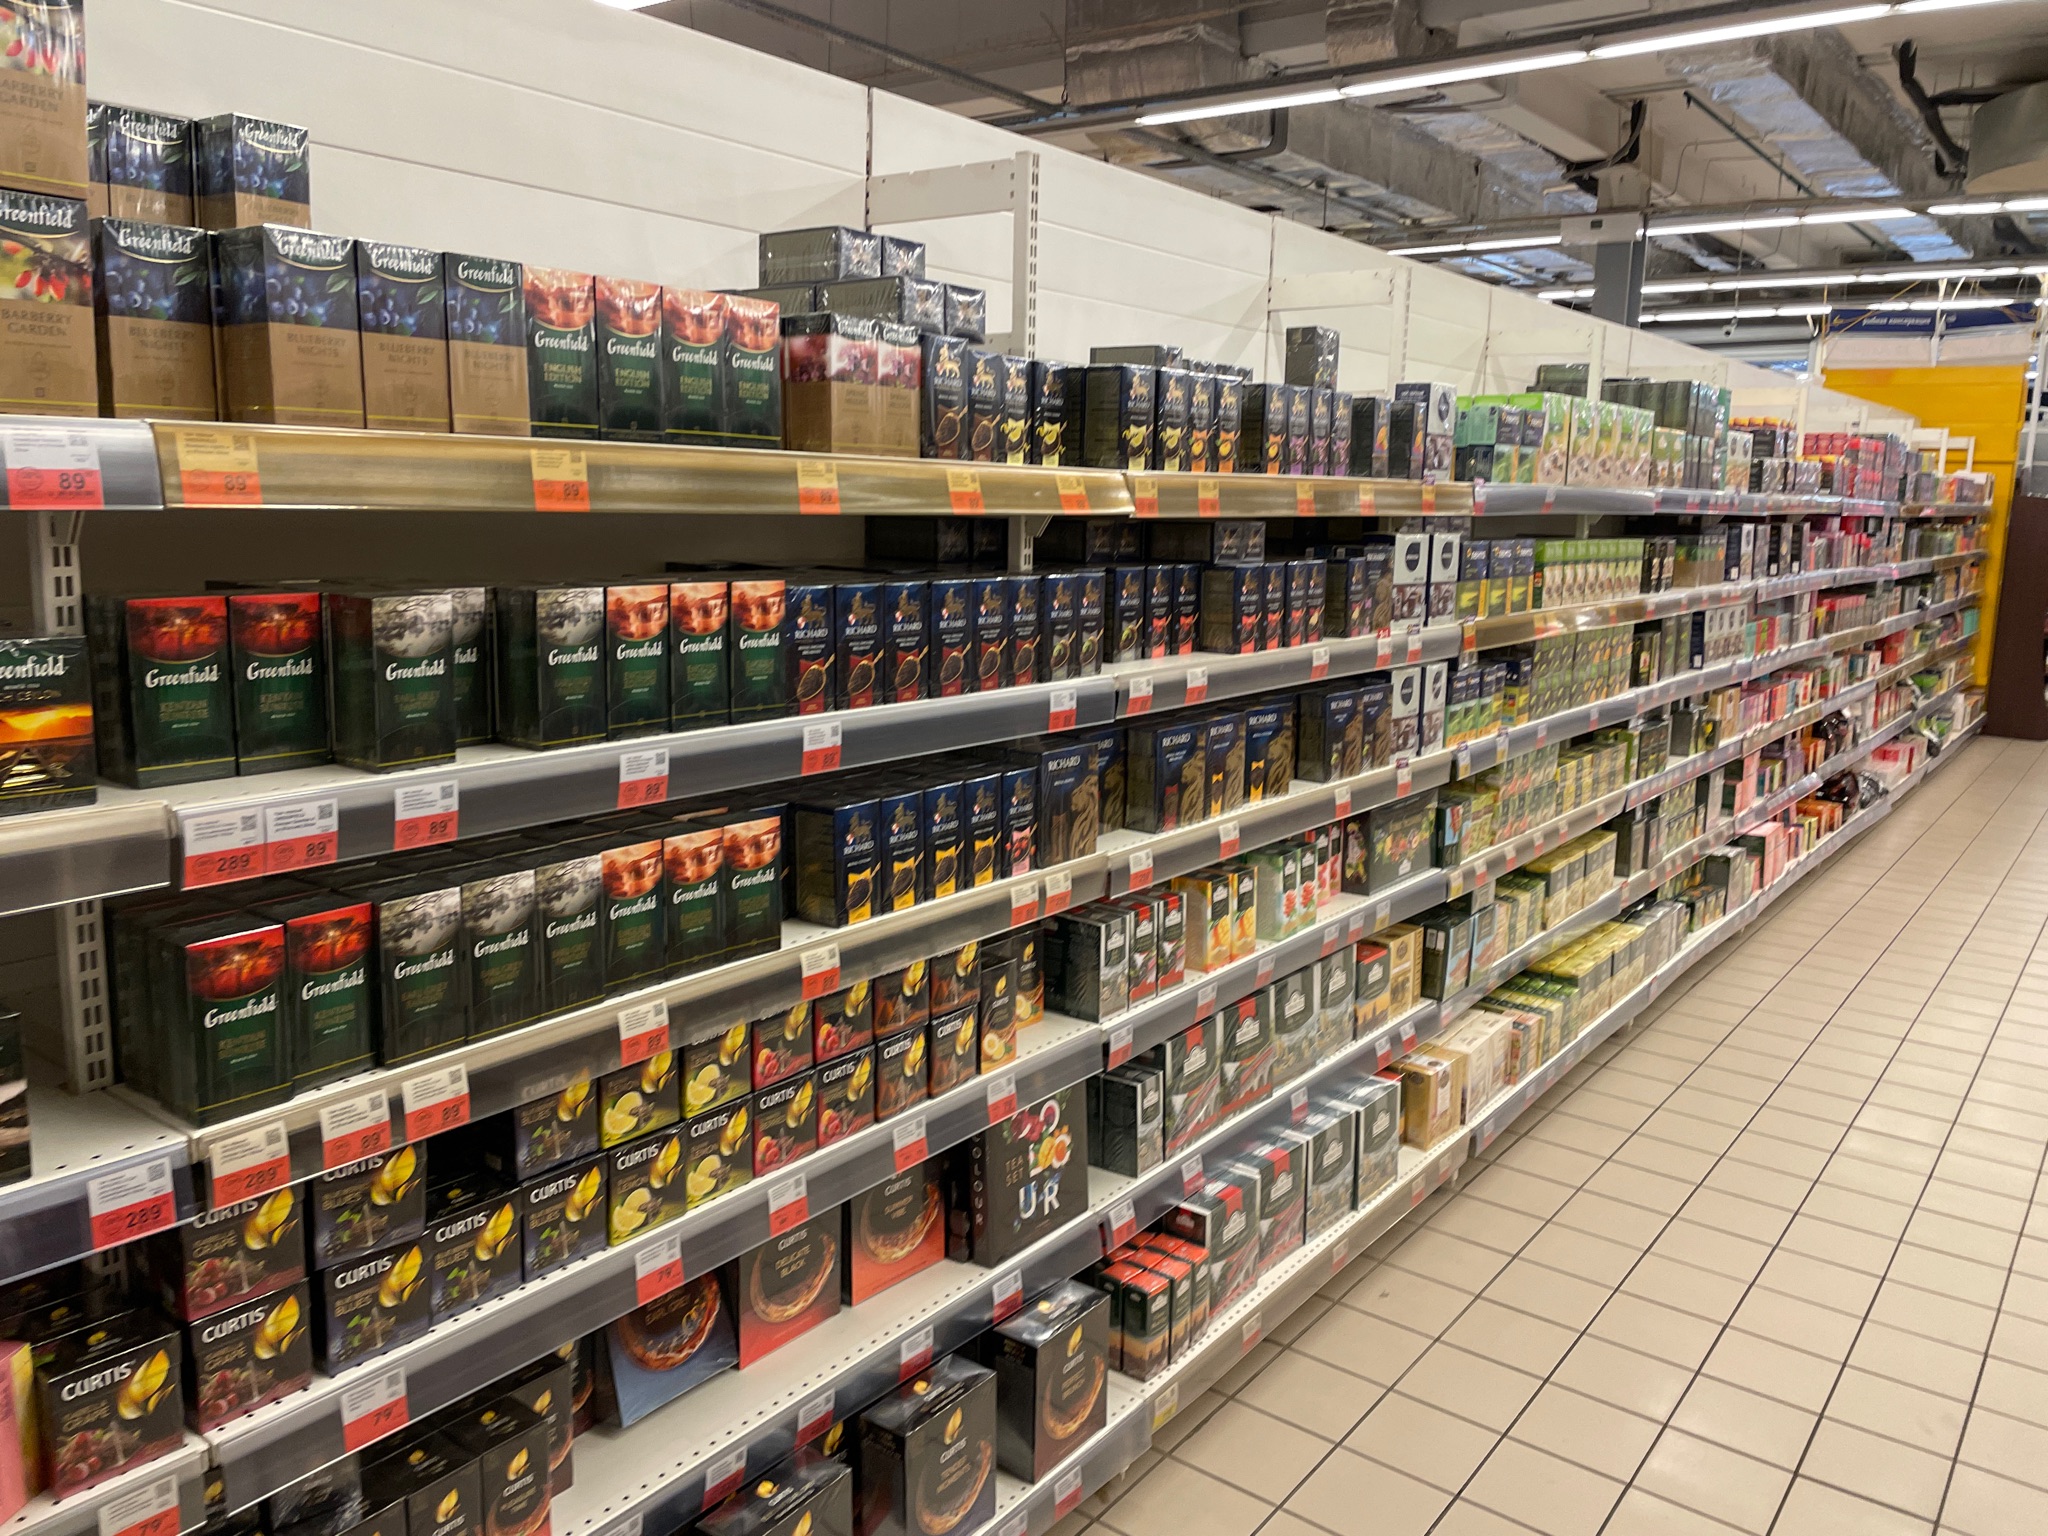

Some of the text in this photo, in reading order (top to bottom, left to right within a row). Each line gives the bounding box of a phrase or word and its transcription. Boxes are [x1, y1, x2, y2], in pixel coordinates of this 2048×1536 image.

[119, 113, 181, 139] Greenfield
[244, 122, 300, 148] Greenfield
[118, 228, 194, 254] Greenfield
[371, 250, 434, 276] Greenfield
[457, 261, 515, 286] Greenfield
[534, 330, 589, 352] Greenfield
[607, 338, 656, 359] Greenfield
[672, 345, 718, 366] Greenfield
[731, 352, 774, 372] Greenfield
[59, 472, 86, 490] 89
[223, 475, 247, 491] 89
[616, 641, 662, 661] Greenfield
[679, 635, 723, 654] Greenfield
[739, 632, 780, 651] Greenfield
[454, 646, 478, 665] field
[548, 645, 599, 666] Greenfield
[0, 654, 68, 680] eenfield
[145, 663, 220, 688] Greenfield
[246, 658, 313, 681] Greenfield
[385, 658, 446, 682] Greenfield
[1209, 722, 1234, 738] RICHARD
[1248, 712, 1277, 727] RICHARD
[1161, 732, 1191, 749] RICHARD
[1047, 754, 1081, 773] RICHARD
[429, 821, 447, 835] 89
[931, 819, 960, 834] RICHARD
[971, 810, 997, 825] RICHARD
[843, 839, 875, 856] RICHARD
[889, 829, 918, 844] RICHARD
[305, 841, 326, 858] 89
[216, 853, 250, 874] 289
[731, 866, 776, 890] Greenfield
[672, 879, 719, 905] Greenfield
[609, 894, 657, 921] Greenfield
[545, 911, 597, 939] Greenfield
[473, 928, 530, 959] Greenfield
[394, 948, 456, 981] Greenfield
[301, 966, 366, 1001] Greenfield
[203, 992, 279, 1030] Greenfield
[823, 1063, 856, 1085] CURTIS
[760, 1087, 797, 1110] CURTIS
[441, 1106, 460, 1122] 89
[690, 1111, 731, 1138] CURTIS
[616, 1142, 661, 1171] CURTIS
[1004, 1154, 1025, 1173] TEA
[242, 1166, 278, 1190] 289
[530, 1173, 578, 1204] CURTIS
[884, 1176, 913, 1197] CURTIS
[1005, 1168, 1025, 1188] SET
[126, 1205, 163, 1229] 289
[435, 1210, 490, 1243] CURTIS
[777, 1227, 809, 1251] CURTIS
[775, 1243, 812, 1271] DELICATE
[334, 1254, 395, 1289] CURTIS
[657, 1266, 672, 1283] 79
[780, 1258, 807, 1279] BLACK
[201, 1304, 269, 1344] CURTIS
[60, 1360, 136, 1402] CURTIS
[373, 1407, 394, 1426] 79
[503, 1472, 536, 1498] CURTIS
[139, 1518, 163, 1535] 79
